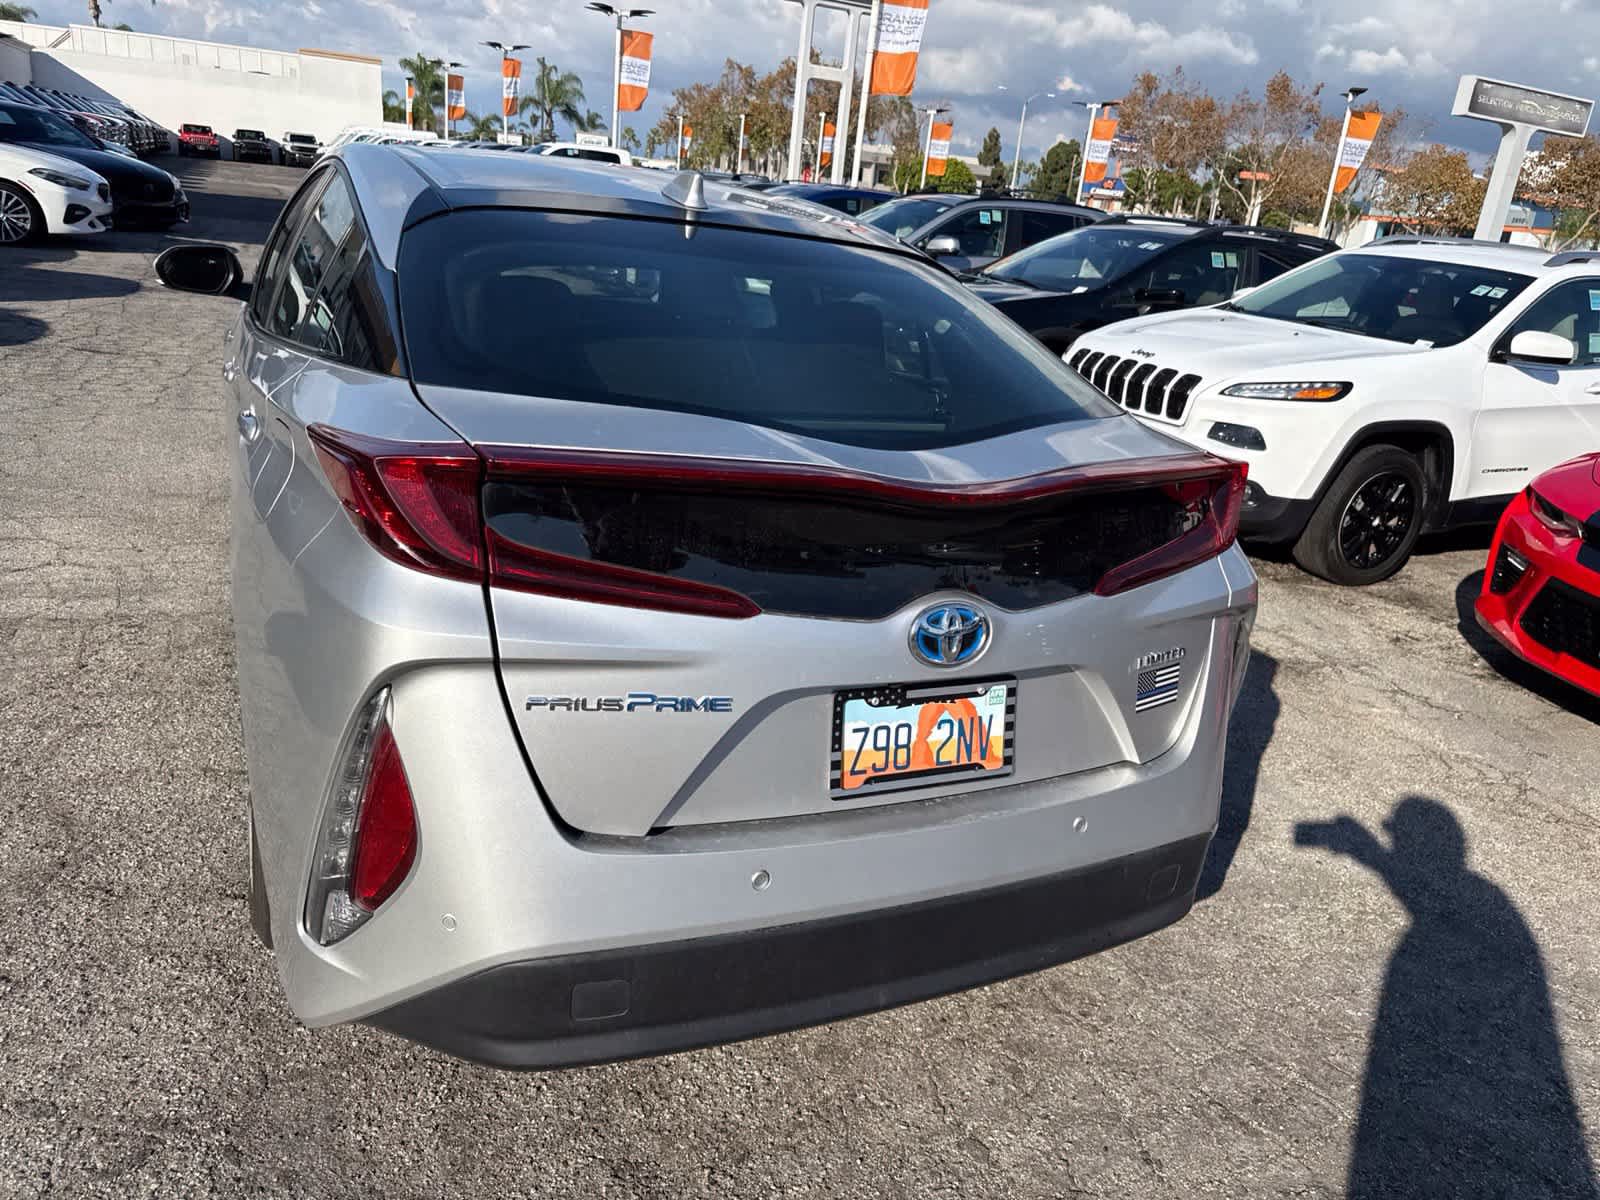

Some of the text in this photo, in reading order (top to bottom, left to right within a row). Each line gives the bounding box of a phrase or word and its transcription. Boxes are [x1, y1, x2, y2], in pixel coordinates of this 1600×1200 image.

[1481, 466, 1529, 474] CHEROKEE
[1136, 647, 1186, 669] LIMITED
[525, 693, 734, 712] PRIUS PRIME
[850, 714, 993, 776] Z98 2NV
